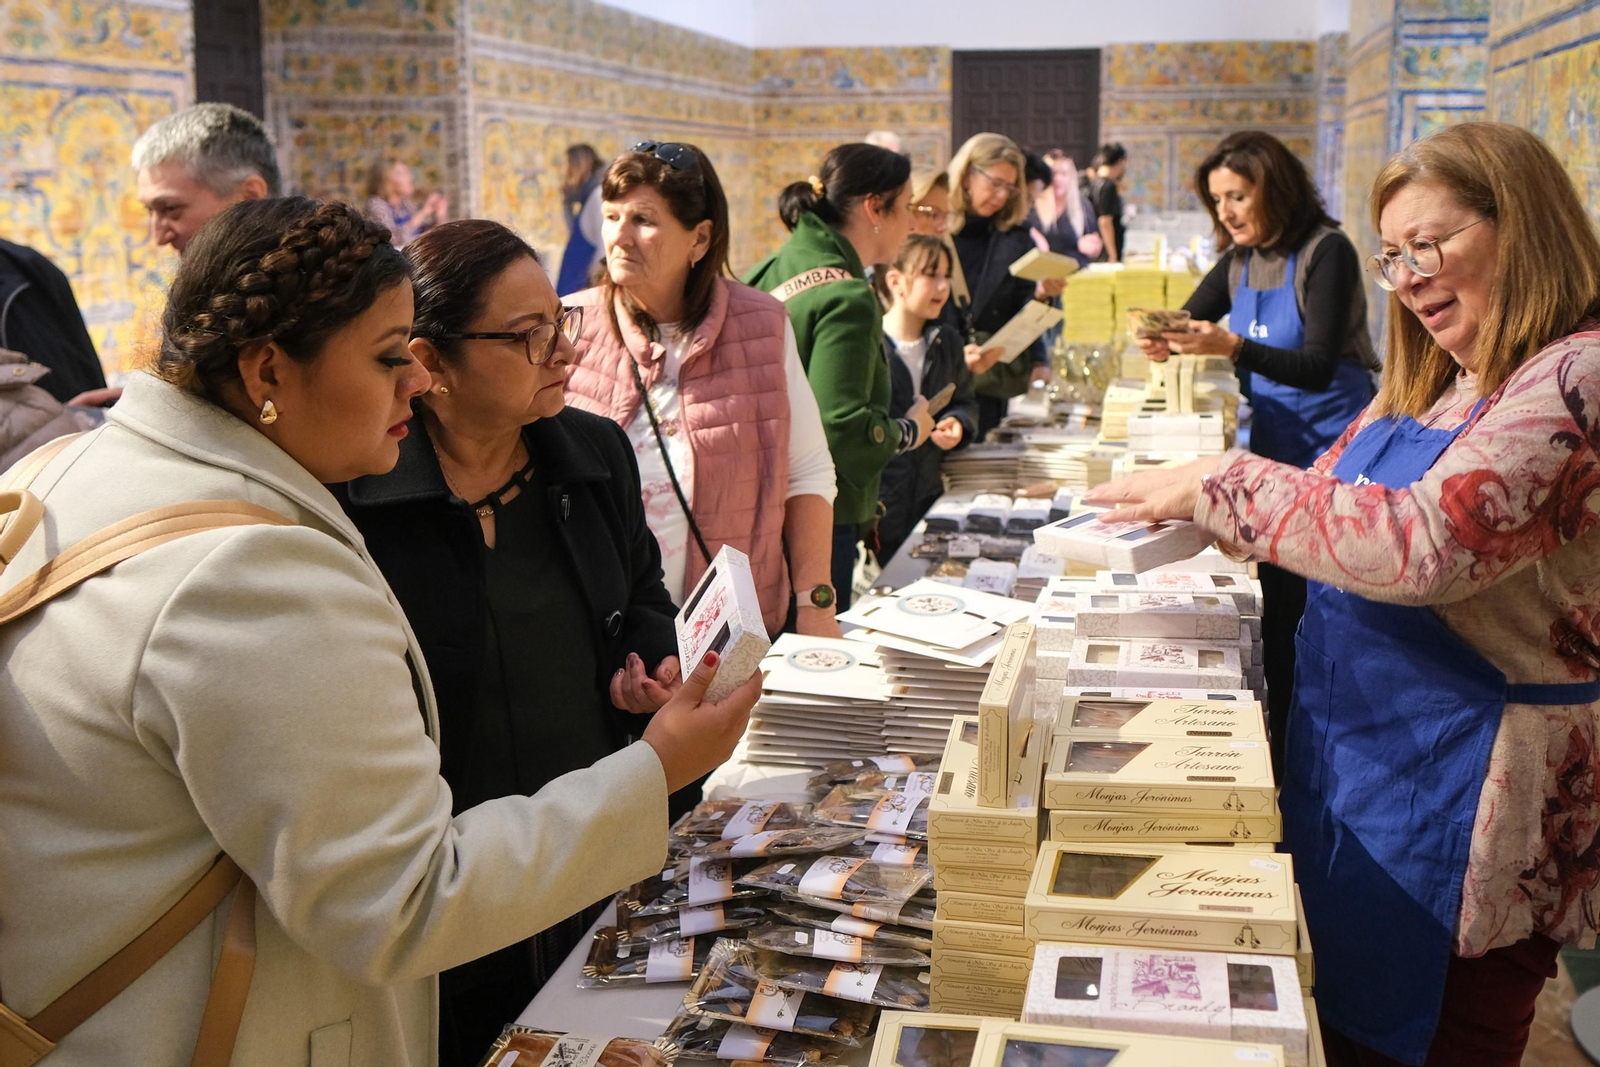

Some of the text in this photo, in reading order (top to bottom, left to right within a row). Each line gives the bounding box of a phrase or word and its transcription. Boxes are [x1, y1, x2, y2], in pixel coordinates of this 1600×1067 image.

[784, 268, 846, 296] BIMBAY
[1174, 704, 1237, 716] Turrón
[1154, 715, 1239, 727] Artesano
[1174, 746, 1243, 758] Turrón
[1154, 758, 1244, 771] Artesano
[1076, 787, 1194, 804] Monjas Jerónimas
[1083, 819, 1202, 835] Monjas Jerónimas
[1156, 869, 1267, 888] Monjas
[1147, 882, 1279, 899] Jerónimas
[1061, 916, 1201, 937] Monjas Jerónimas
[1116, 997, 1227, 1024] Brandy
